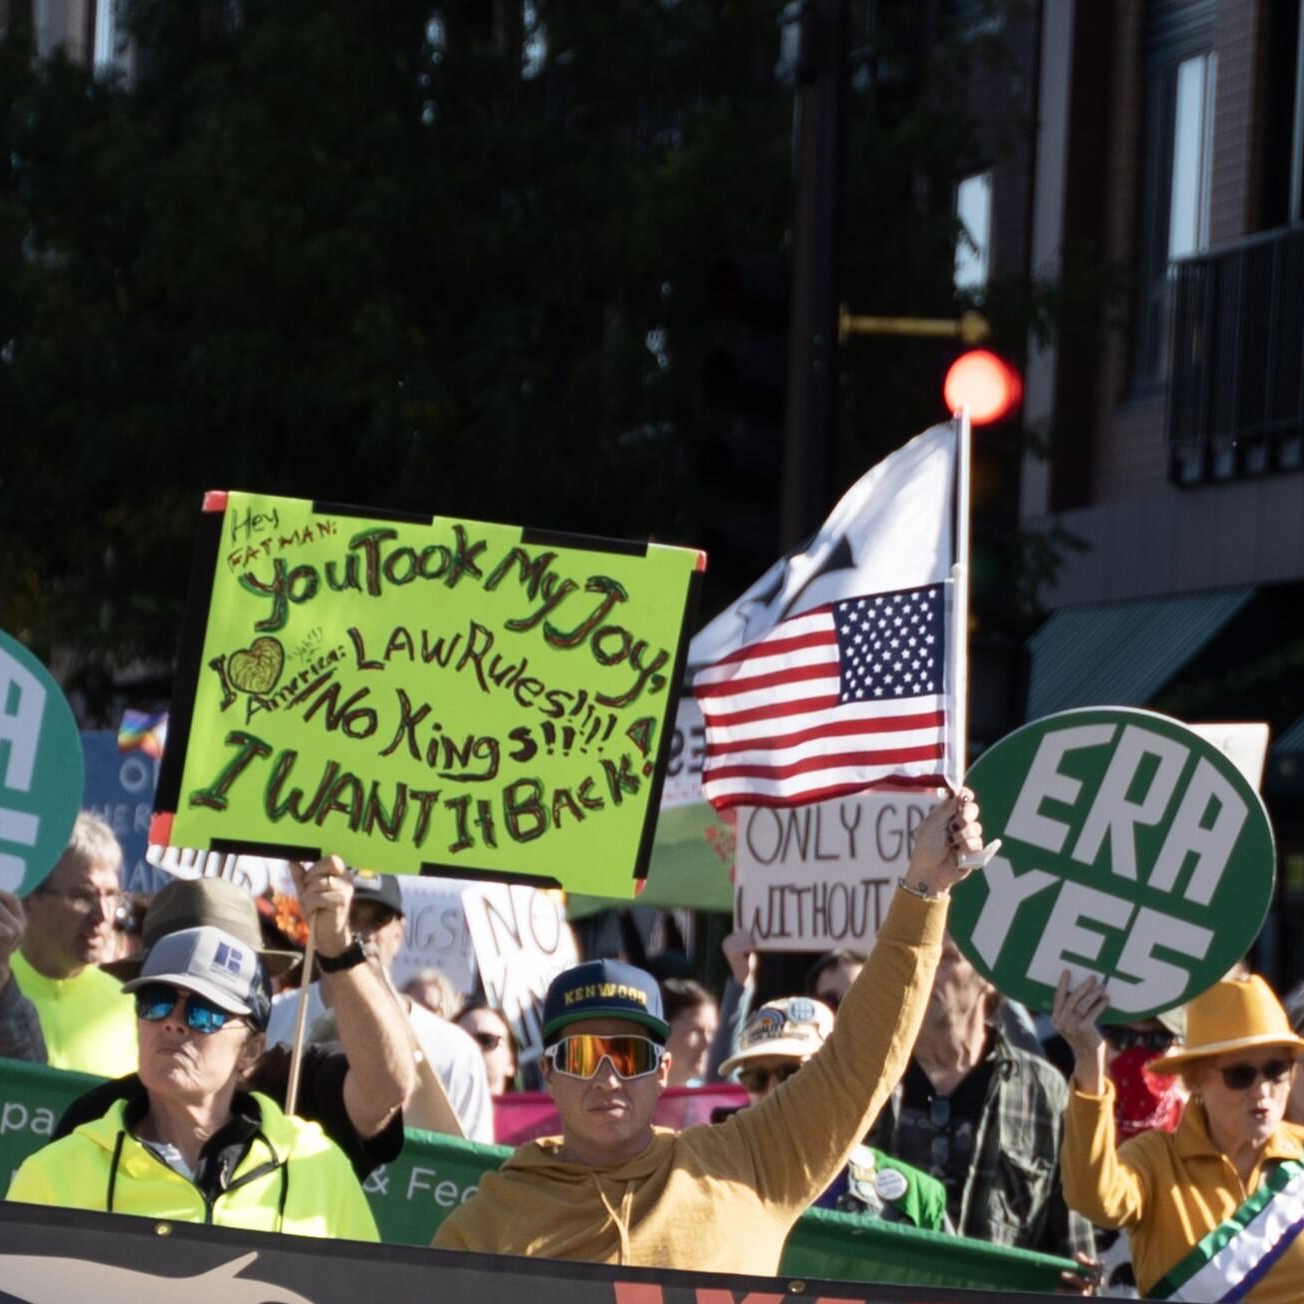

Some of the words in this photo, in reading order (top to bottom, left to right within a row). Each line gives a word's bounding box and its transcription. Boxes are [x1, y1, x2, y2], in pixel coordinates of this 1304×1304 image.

[231, 508, 279, 546] Hey
[483, 547, 579, 633] My
[189, 730, 273, 812] I
[264, 750, 442, 849] WANT
[1004, 723, 1248, 906] ERA
[747, 803, 861, 864] ONLY
[482, 884, 561, 955] NO
[737, 878, 890, 940] WITHOUT
[971, 856, 1214, 1013] YES
[563, 983, 648, 1006] KENWOOD
